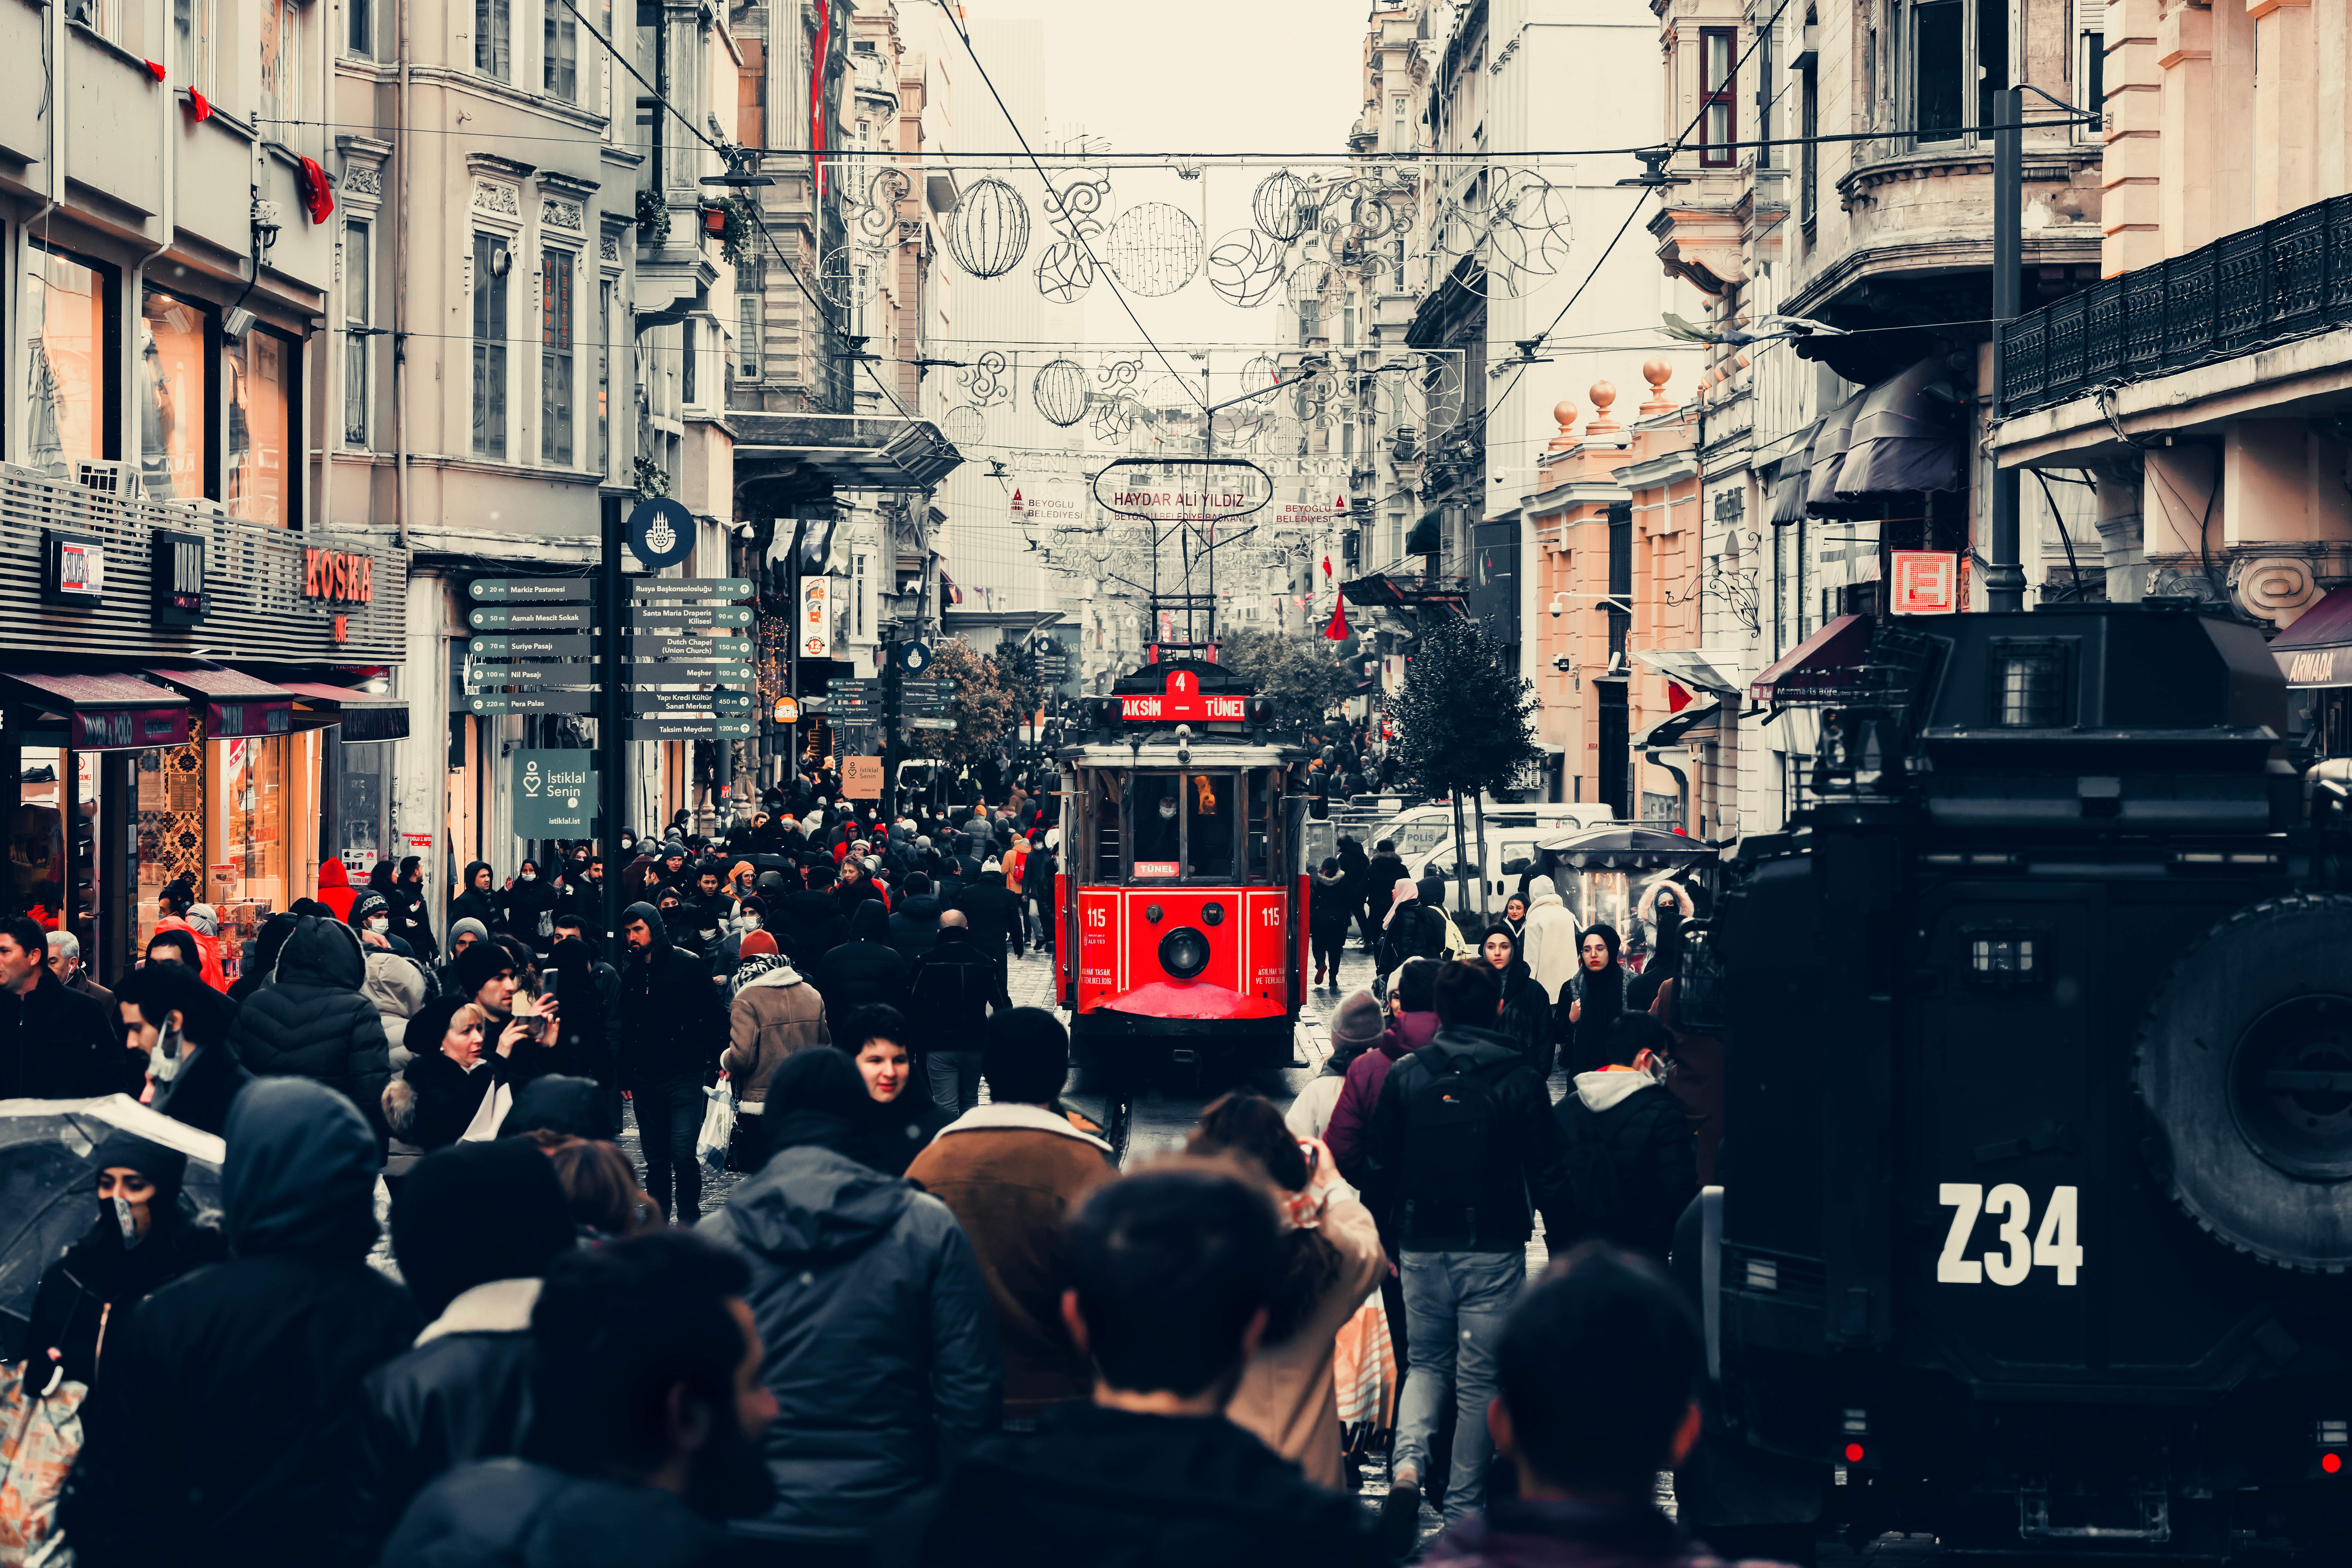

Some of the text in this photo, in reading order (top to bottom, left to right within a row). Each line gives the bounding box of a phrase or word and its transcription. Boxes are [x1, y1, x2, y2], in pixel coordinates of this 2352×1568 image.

[1010, 449, 1068, 472] YENİ
[1266, 458, 1352, 477] OLSUN
[1029, 499, 1073, 508] BEYOĞLU
[1115, 491, 1244, 507] HAYDAR ALİ YILDIZ
[1286, 502, 1331, 512] BEYOĞLU
[1028, 510, 1082, 519] BELEDİYESİ
[66, 552, 86, 583] SILVER
[174, 542, 201, 593] DURU
[306, 548, 372, 602] KOSKA
[657, 585, 712, 593] Başkonsolosluğu
[683, 610, 712, 618] Draperis
[686, 645, 712, 655] Church)
[689, 639, 712, 647] Chapel
[2289, 653, 2333, 683] ARMADA
[1175, 673, 1185, 691] 4
[774, 709, 798, 718] BURGER
[1122, 697, 1161, 716] AKSİM
[1205, 697, 1245, 716] TÜNEL
[221, 706, 243, 734] DURU
[114, 715, 133, 745] POLO
[684, 726, 712, 734] Meydanı
[548, 770, 585, 783] İstiklal
[547, 785, 580, 797] Senin
[1407, 832, 1434, 842] POLİS
[1140, 864, 1174, 873] TÜNEL
[1087, 908, 1105, 927] 115
[1262, 907, 1279, 926] 115
[1938, 1183, 2083, 1286] Z34
